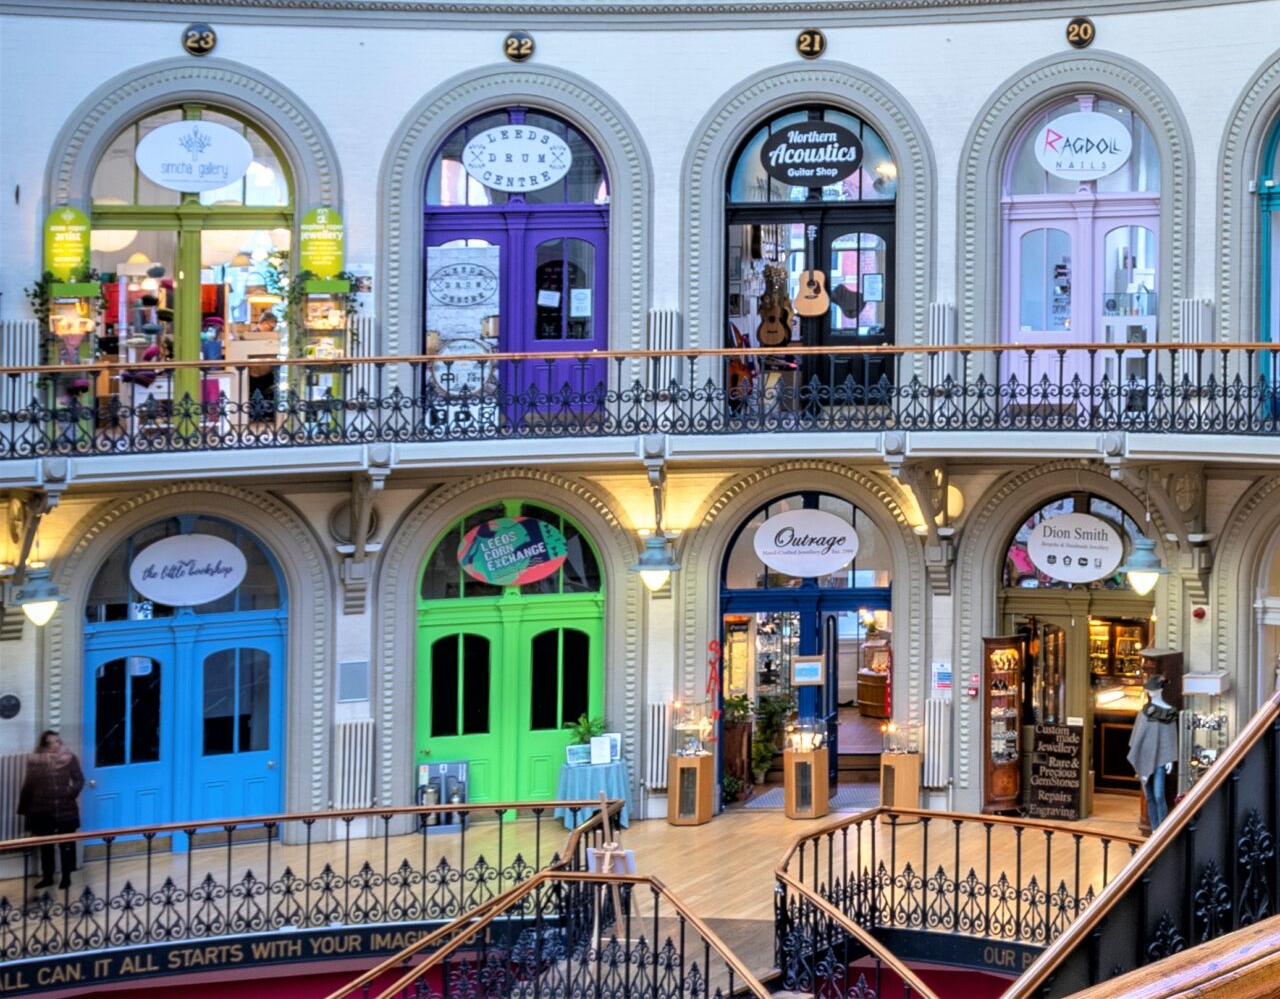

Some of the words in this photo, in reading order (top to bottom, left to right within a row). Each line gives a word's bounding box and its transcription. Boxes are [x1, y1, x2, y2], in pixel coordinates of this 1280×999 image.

[186, 30, 214, 48] 23
[1068, 23, 1092, 41] 20
[507, 37, 532, 54] 22
[799, 34, 821, 51] 21
[486, 129, 550, 145] LEEDS
[787, 130, 838, 144] Northern
[1043, 128, 1122, 157] RAGDOLL
[488, 153, 546, 163] DRUM
[768, 143, 857, 166] Acoustics
[198, 162, 229, 179] gallery
[787, 168, 815, 177] Guitar
[816, 167, 838, 177] Shop
[1055, 161, 1107, 169] NAILS
[482, 170, 552, 188] CENTRE
[54, 231, 82, 241] artist
[300, 230, 344, 241] jewellery
[774, 526, 847, 555] Outrage
[1042, 525, 1071, 539] Dion
[1074, 527, 1109, 541] Smith
[480, 531, 517, 552] LEEDS
[483, 543, 515, 562] CORN
[486, 542, 547, 572] EXCHANGE
[142, 564, 158, 580] the
[1035, 724, 1070, 736] Custom
[1055, 732, 1080, 744] made
[1037, 740, 1079, 757] Jewellery
[1048, 756, 1071, 769] Rare
[1070, 756, 1080, 769] &
[1039, 765, 1078, 778] Precious
[1031, 775, 1080, 789] GemStones
[1038, 789, 1073, 804] Repairs
[37, 962, 86, 986] CAN.
[94, 957, 113, 978] IT
[119, 954, 160, 975] ALL
[168, 944, 244, 969] STARTS
[251, 938, 302, 960] WITH
[310, 934, 362, 955] YOUR
[983, 946, 1016, 969] OUR
